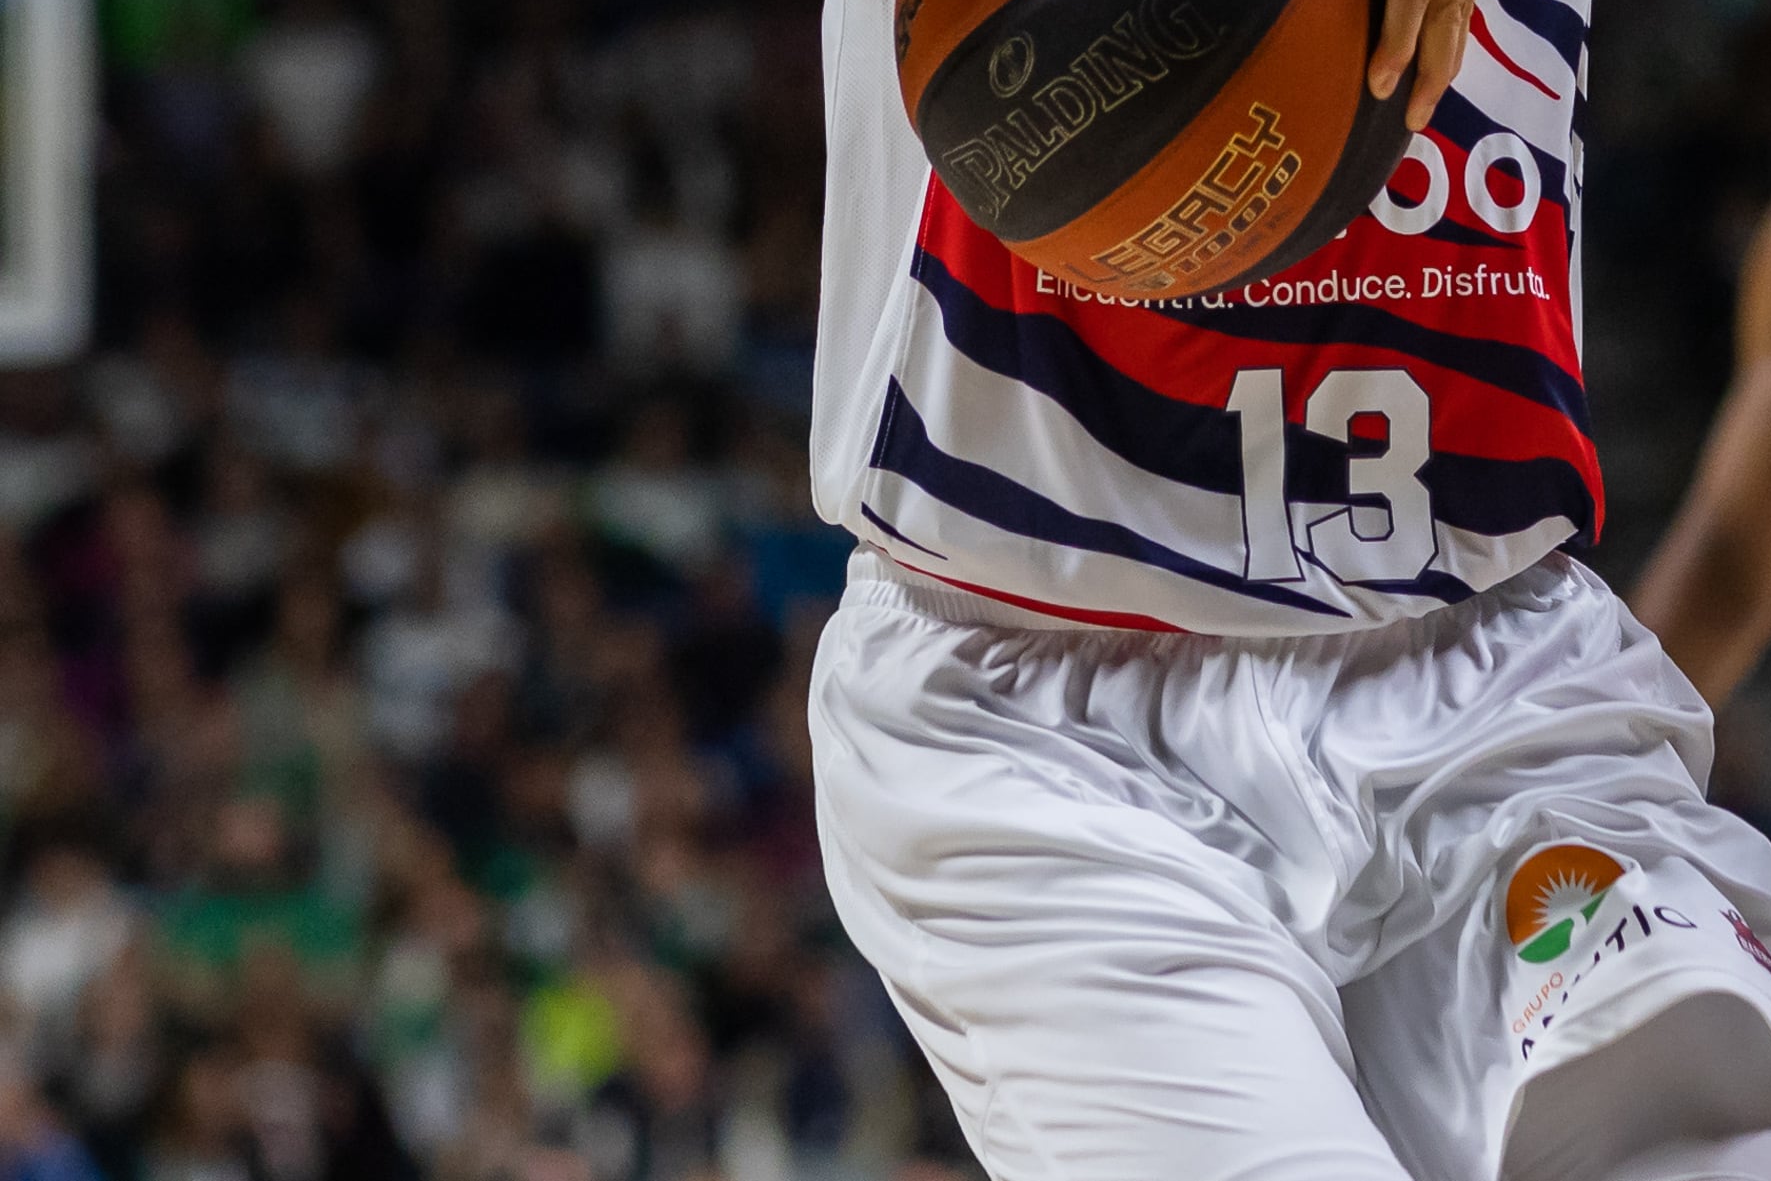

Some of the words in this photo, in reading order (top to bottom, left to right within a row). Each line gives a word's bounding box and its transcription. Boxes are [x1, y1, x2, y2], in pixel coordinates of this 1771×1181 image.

[1064, 101, 1286, 284] LEGACY
[1244, 270, 1412, 308] Conduce.
[1421, 264, 1551, 301] Disfruta.
[1226, 366, 1438, 585] 13
[1512, 971, 1565, 1035] GRUPO
